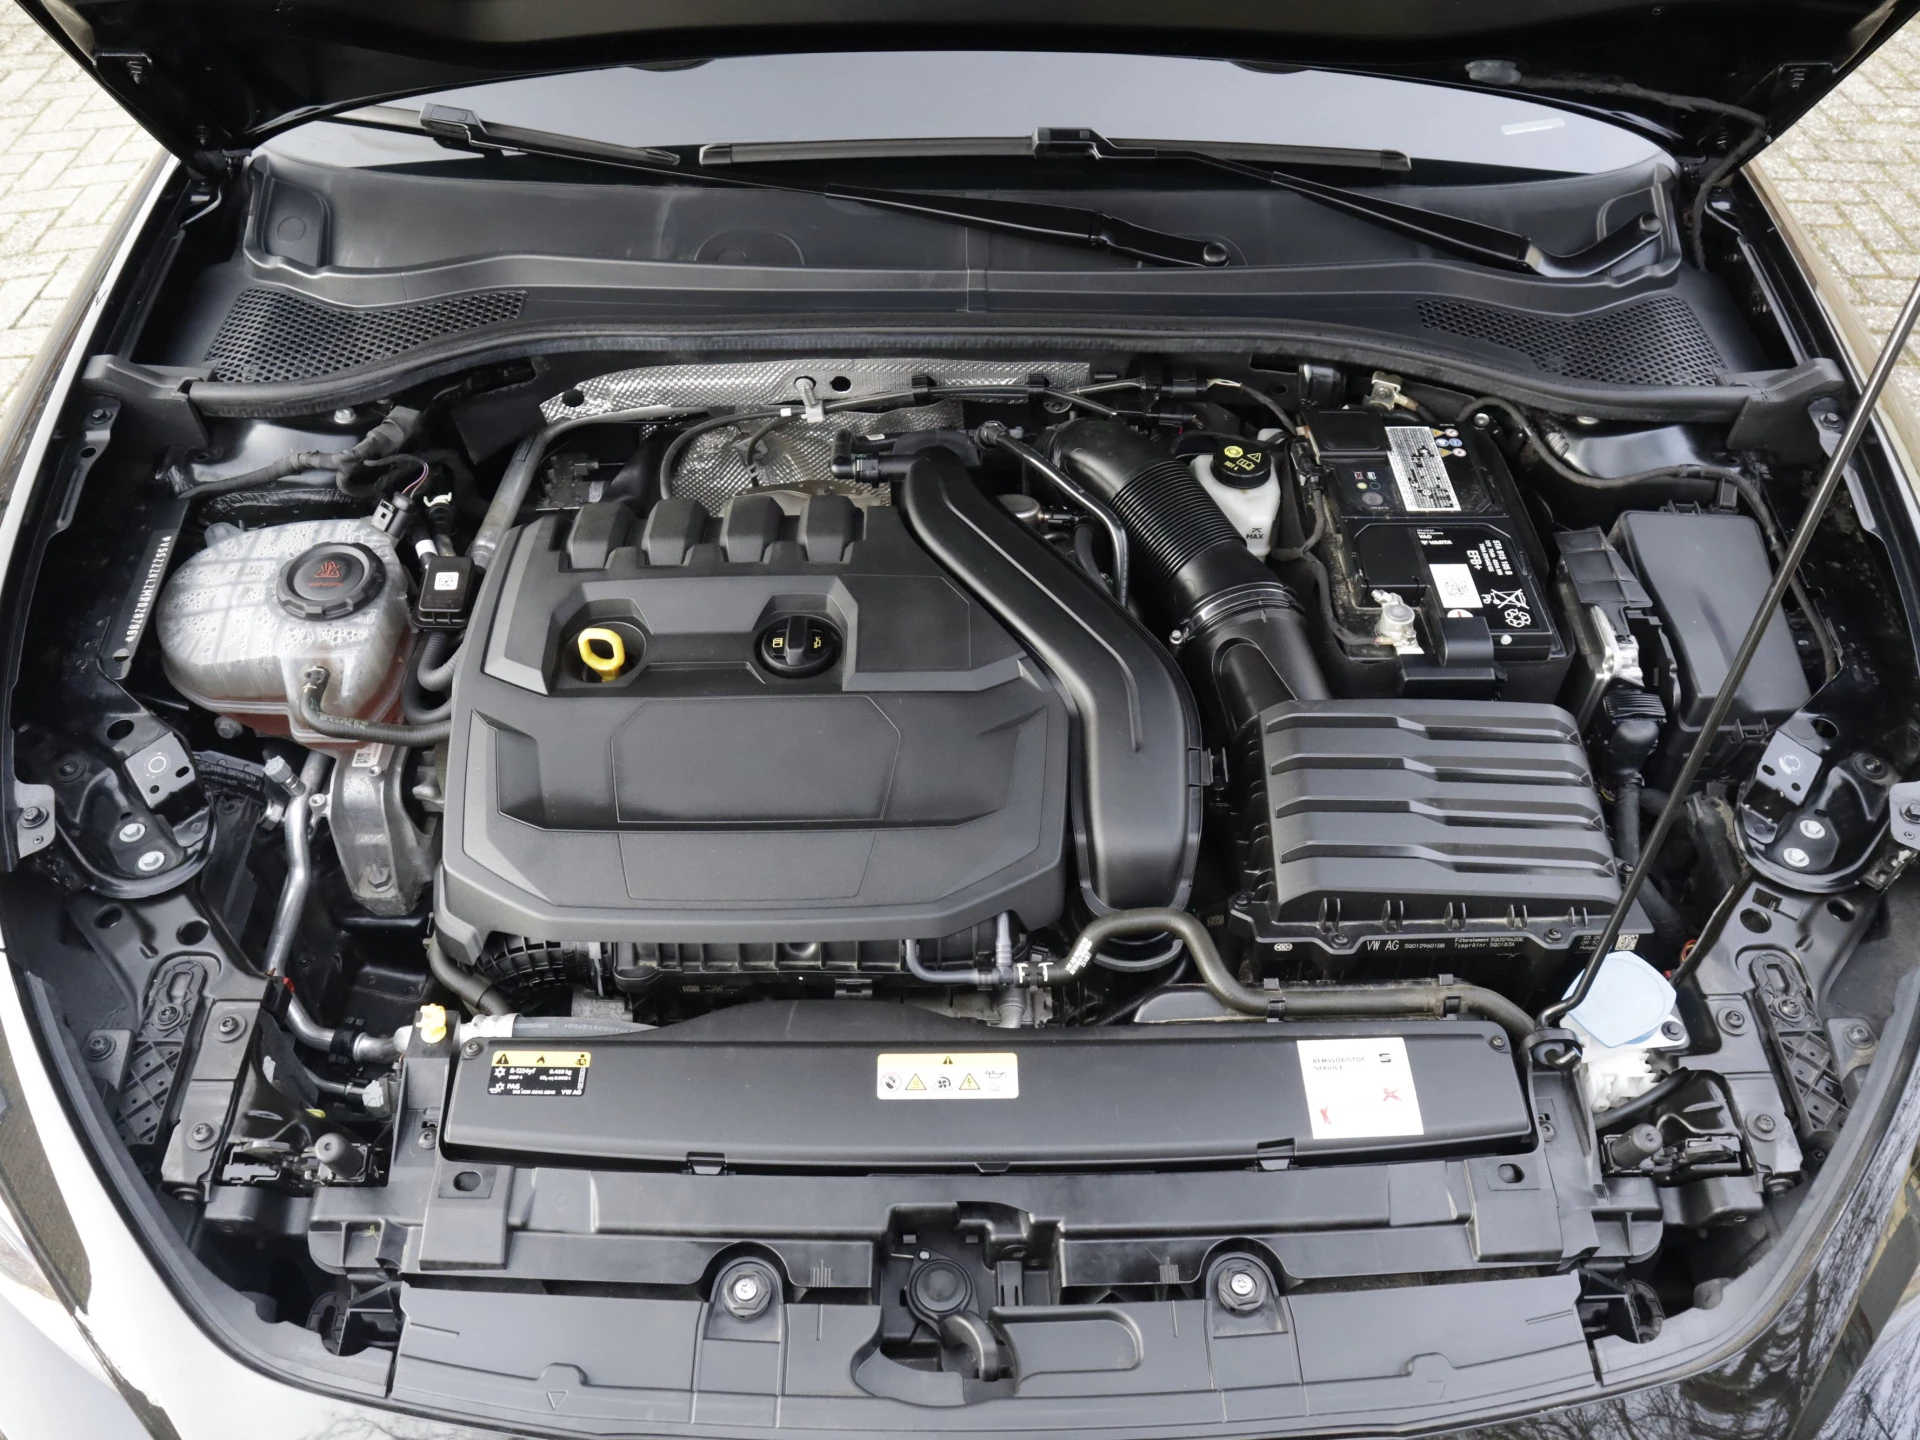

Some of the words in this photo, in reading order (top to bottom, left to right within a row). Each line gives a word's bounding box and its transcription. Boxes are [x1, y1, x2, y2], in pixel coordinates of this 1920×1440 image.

[1467, 550, 1482, 570] EFB+
[1481, 594, 1492, 604] Pb
[1366, 940, 1380, 951] VW
[1384, 940, 1400, 951] AG
